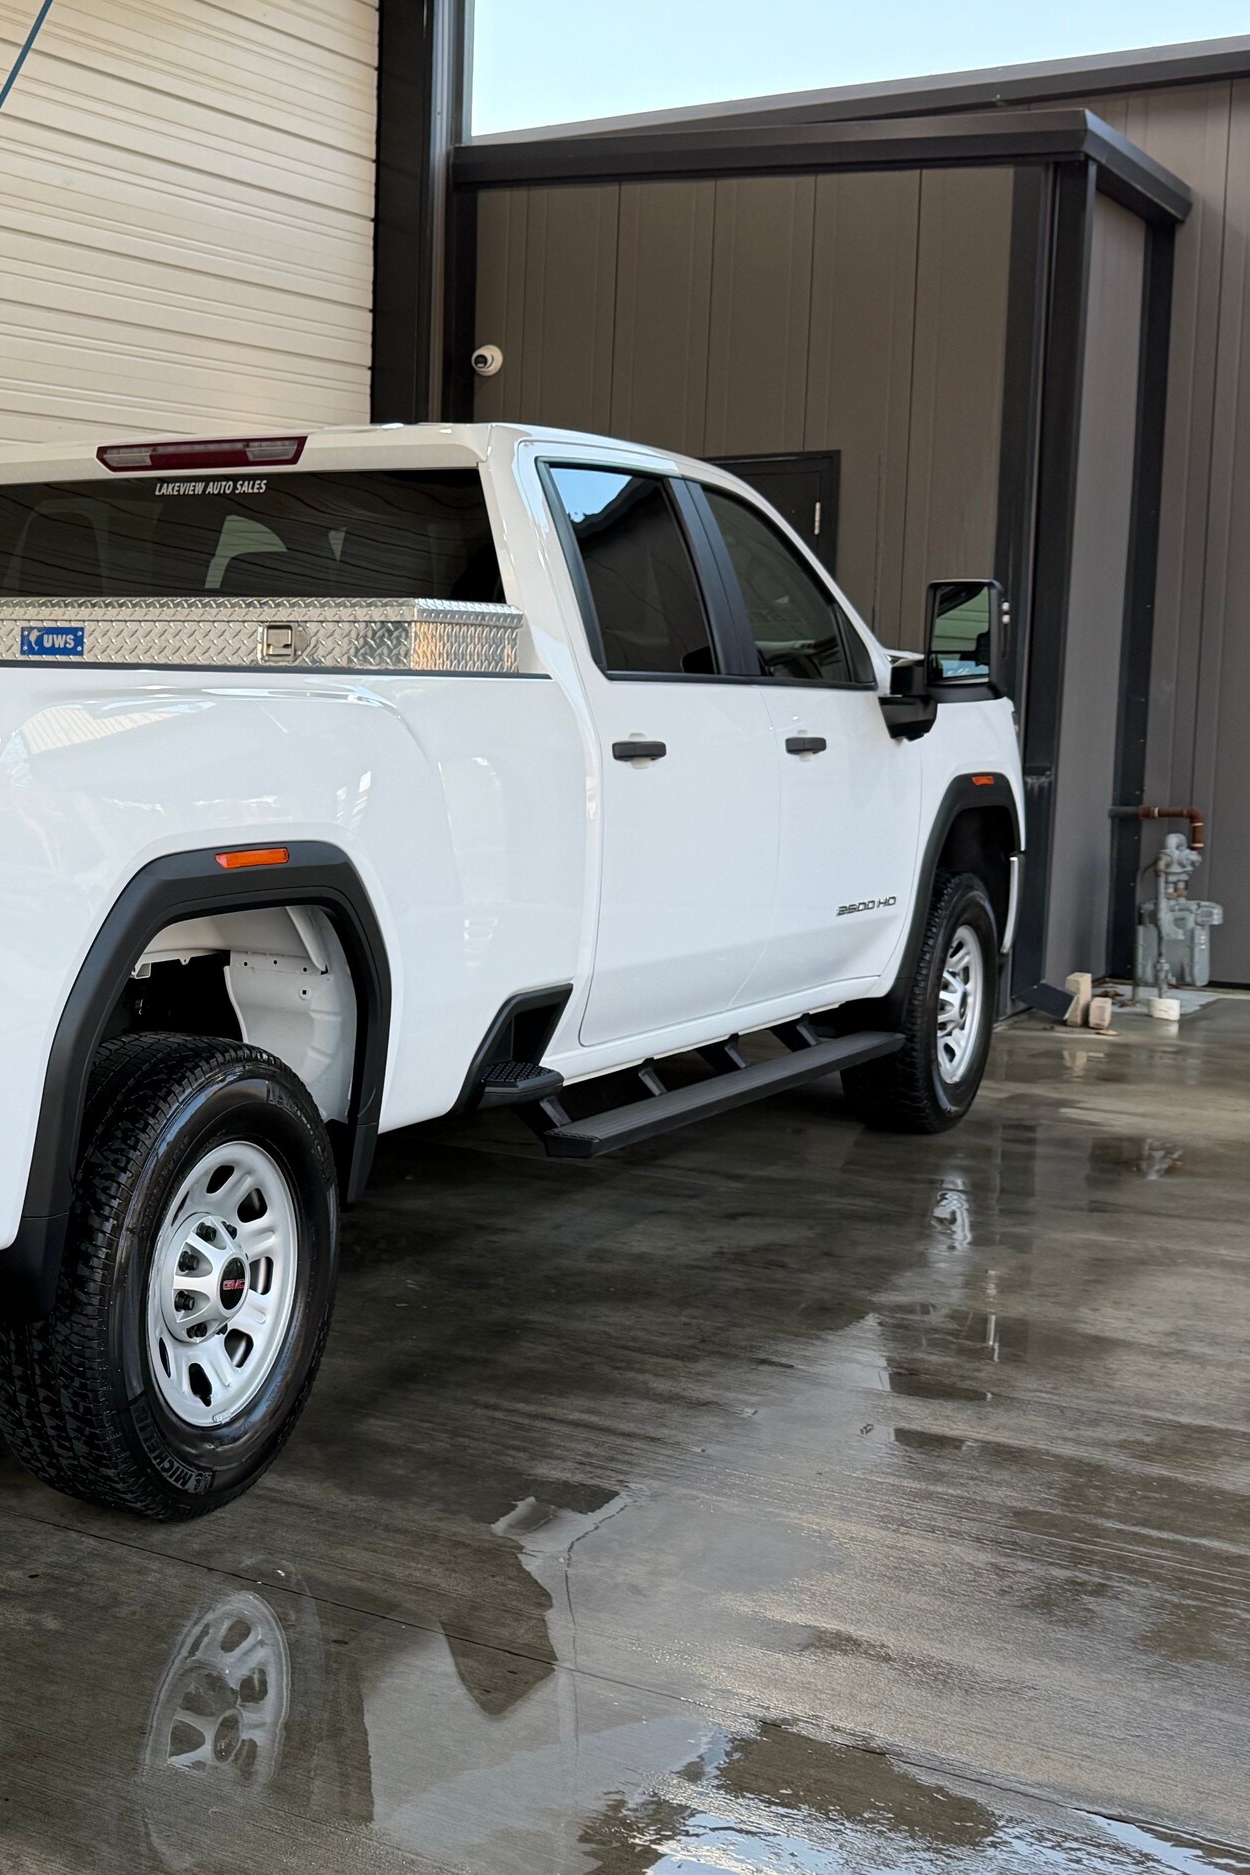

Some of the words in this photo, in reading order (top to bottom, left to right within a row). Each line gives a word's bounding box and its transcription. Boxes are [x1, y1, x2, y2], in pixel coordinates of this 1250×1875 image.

[155, 482, 205, 496] LAKEVIEW
[206, 481, 233, 494] AUTO
[235, 480, 267, 493] SALES
[43, 634, 75, 648] UWS
[877, 896, 897, 908] HD
[222, 1279, 246, 1291] GMC
